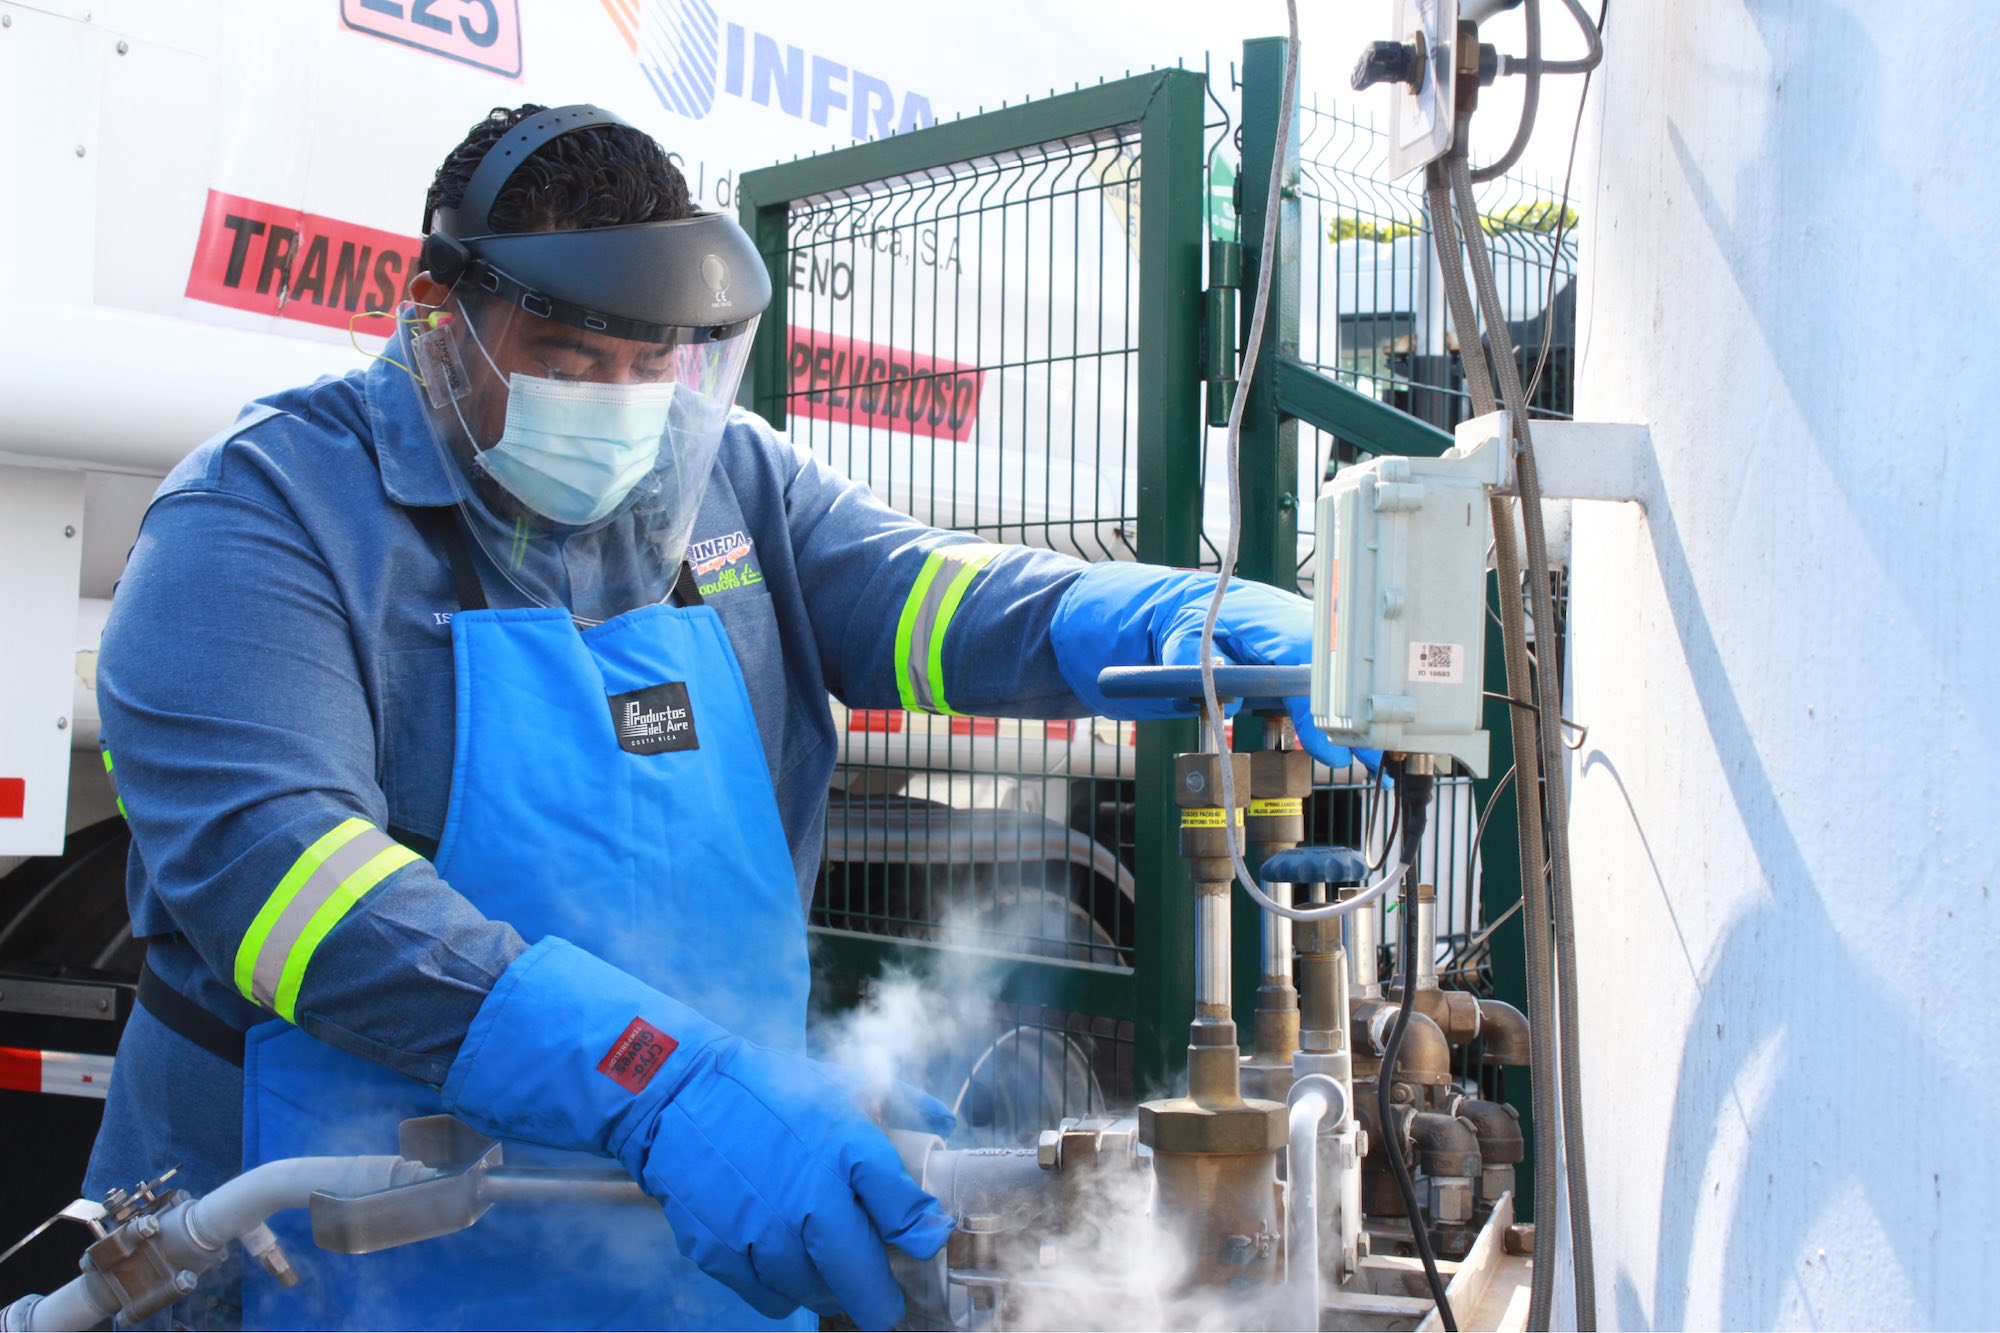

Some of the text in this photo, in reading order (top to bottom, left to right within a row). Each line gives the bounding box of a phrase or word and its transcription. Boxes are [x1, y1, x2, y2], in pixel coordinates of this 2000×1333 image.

[725, 21, 935, 142] INFRA
[788, 249, 854, 301] ENO
[787, 342, 973, 431] PELIGROSO
[693, 533, 747, 561] INFRA
[719, 568, 737, 583] AIR
[629, 700, 687, 726] Productos
[631, 734, 677, 747] COSTA RICA
[648, 720, 689, 735] del Aire
